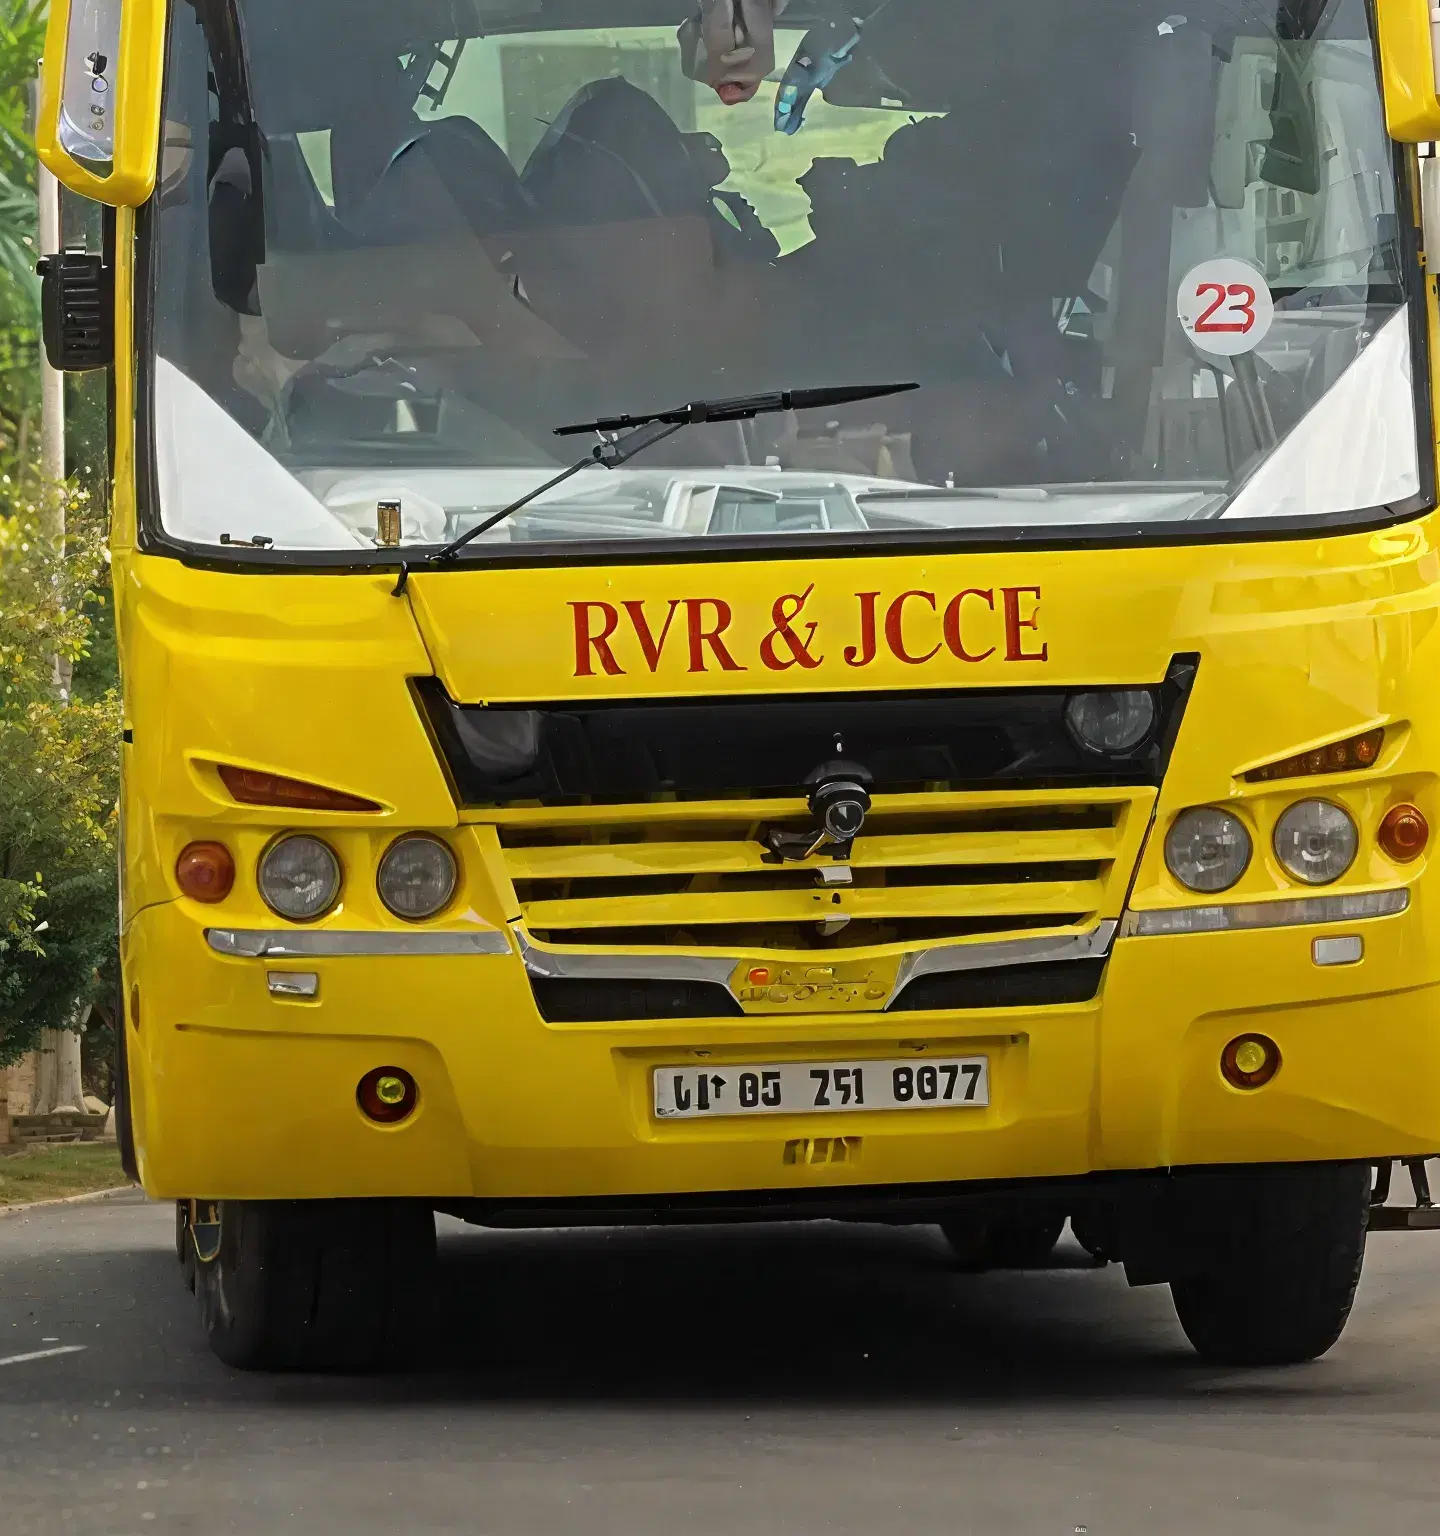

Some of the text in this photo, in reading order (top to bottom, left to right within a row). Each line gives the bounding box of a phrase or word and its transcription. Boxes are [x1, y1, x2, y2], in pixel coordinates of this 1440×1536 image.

[1194, 283, 1256, 334] 23
[566, 583, 1048, 677] RVR & JCCE
